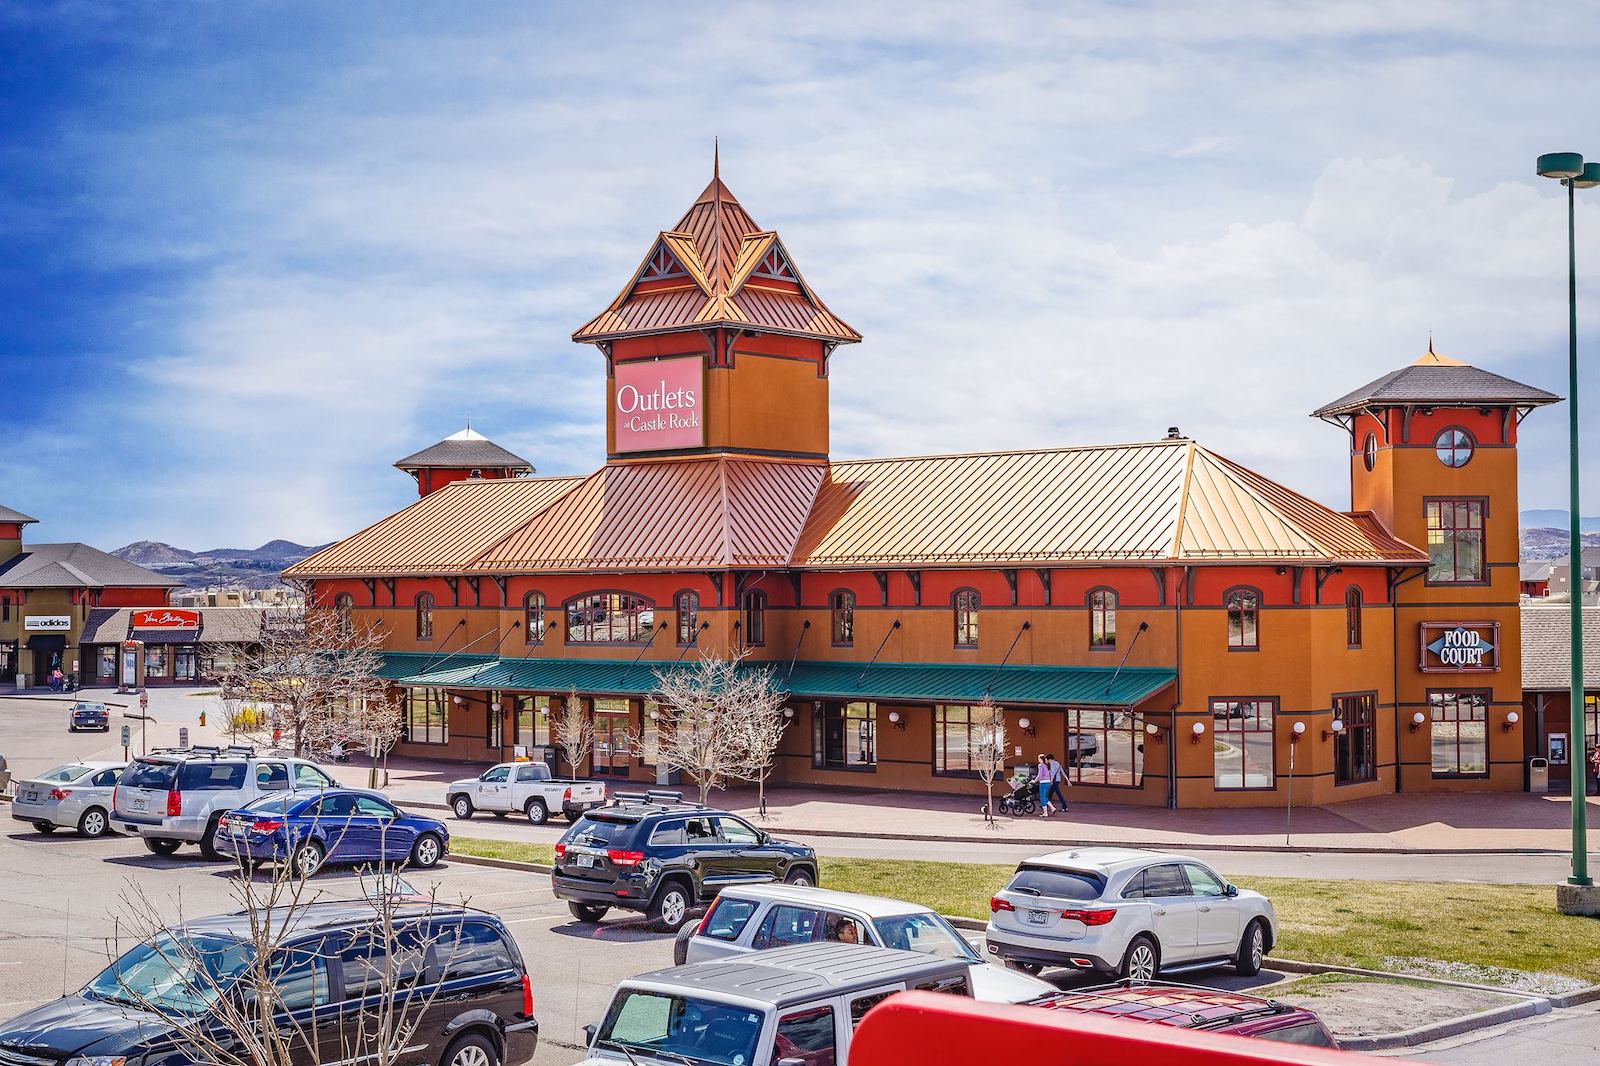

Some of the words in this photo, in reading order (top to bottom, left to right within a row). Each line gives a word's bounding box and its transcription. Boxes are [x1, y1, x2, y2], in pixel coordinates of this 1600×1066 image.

[617, 380, 696, 413] Outlets
[630, 413, 667, 432] Castle
[669, 410, 699, 429] Rock
[40, 619, 69, 627] adidas
[1444, 630, 1480, 647] FOOD
[1440, 647, 1484, 664] COURT
[596, 701, 610, 709] Food
